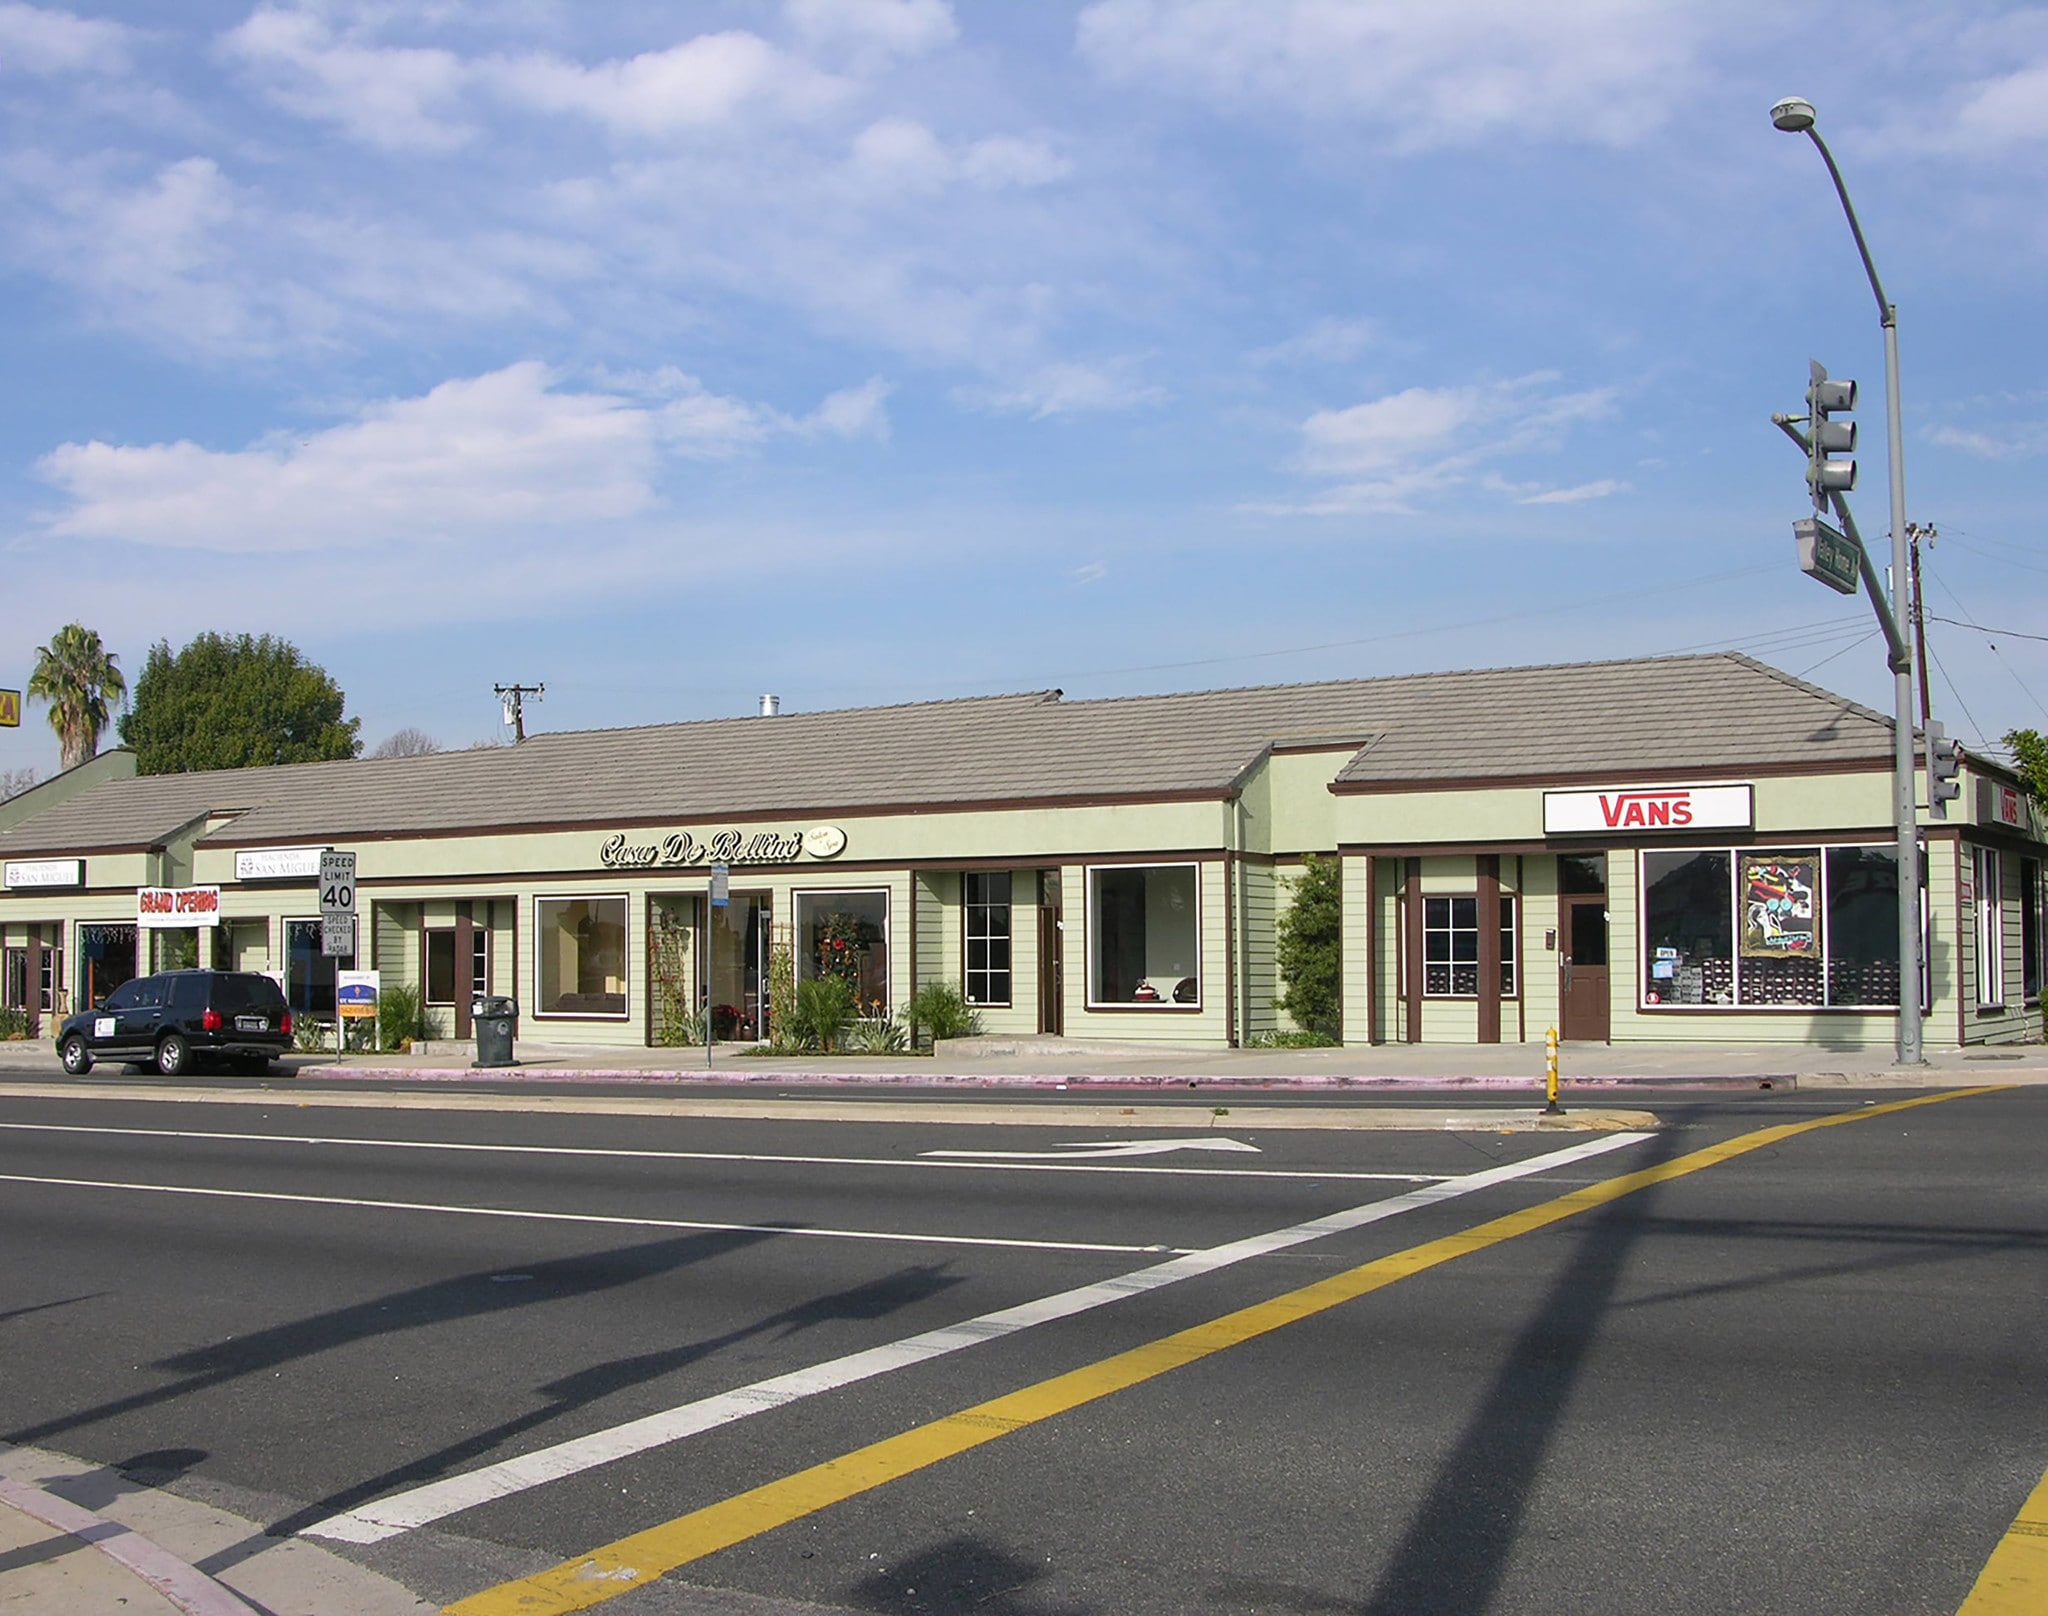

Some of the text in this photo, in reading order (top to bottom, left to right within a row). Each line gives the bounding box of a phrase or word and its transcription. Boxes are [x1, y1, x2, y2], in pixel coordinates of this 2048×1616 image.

[1599, 792, 1693, 827] VANS
[600, 829, 803, 866] Casa De Bellini
[323, 858, 353, 867] SPEED
[325, 872, 350, 881] LIMIT
[323, 885, 351, 907] 40
[140, 891, 173, 913] GRAND
[327, 915, 347, 924] SPEED
[324, 926, 351, 934] CHECKED
[1660, 949, 1674, 957] OPEN
